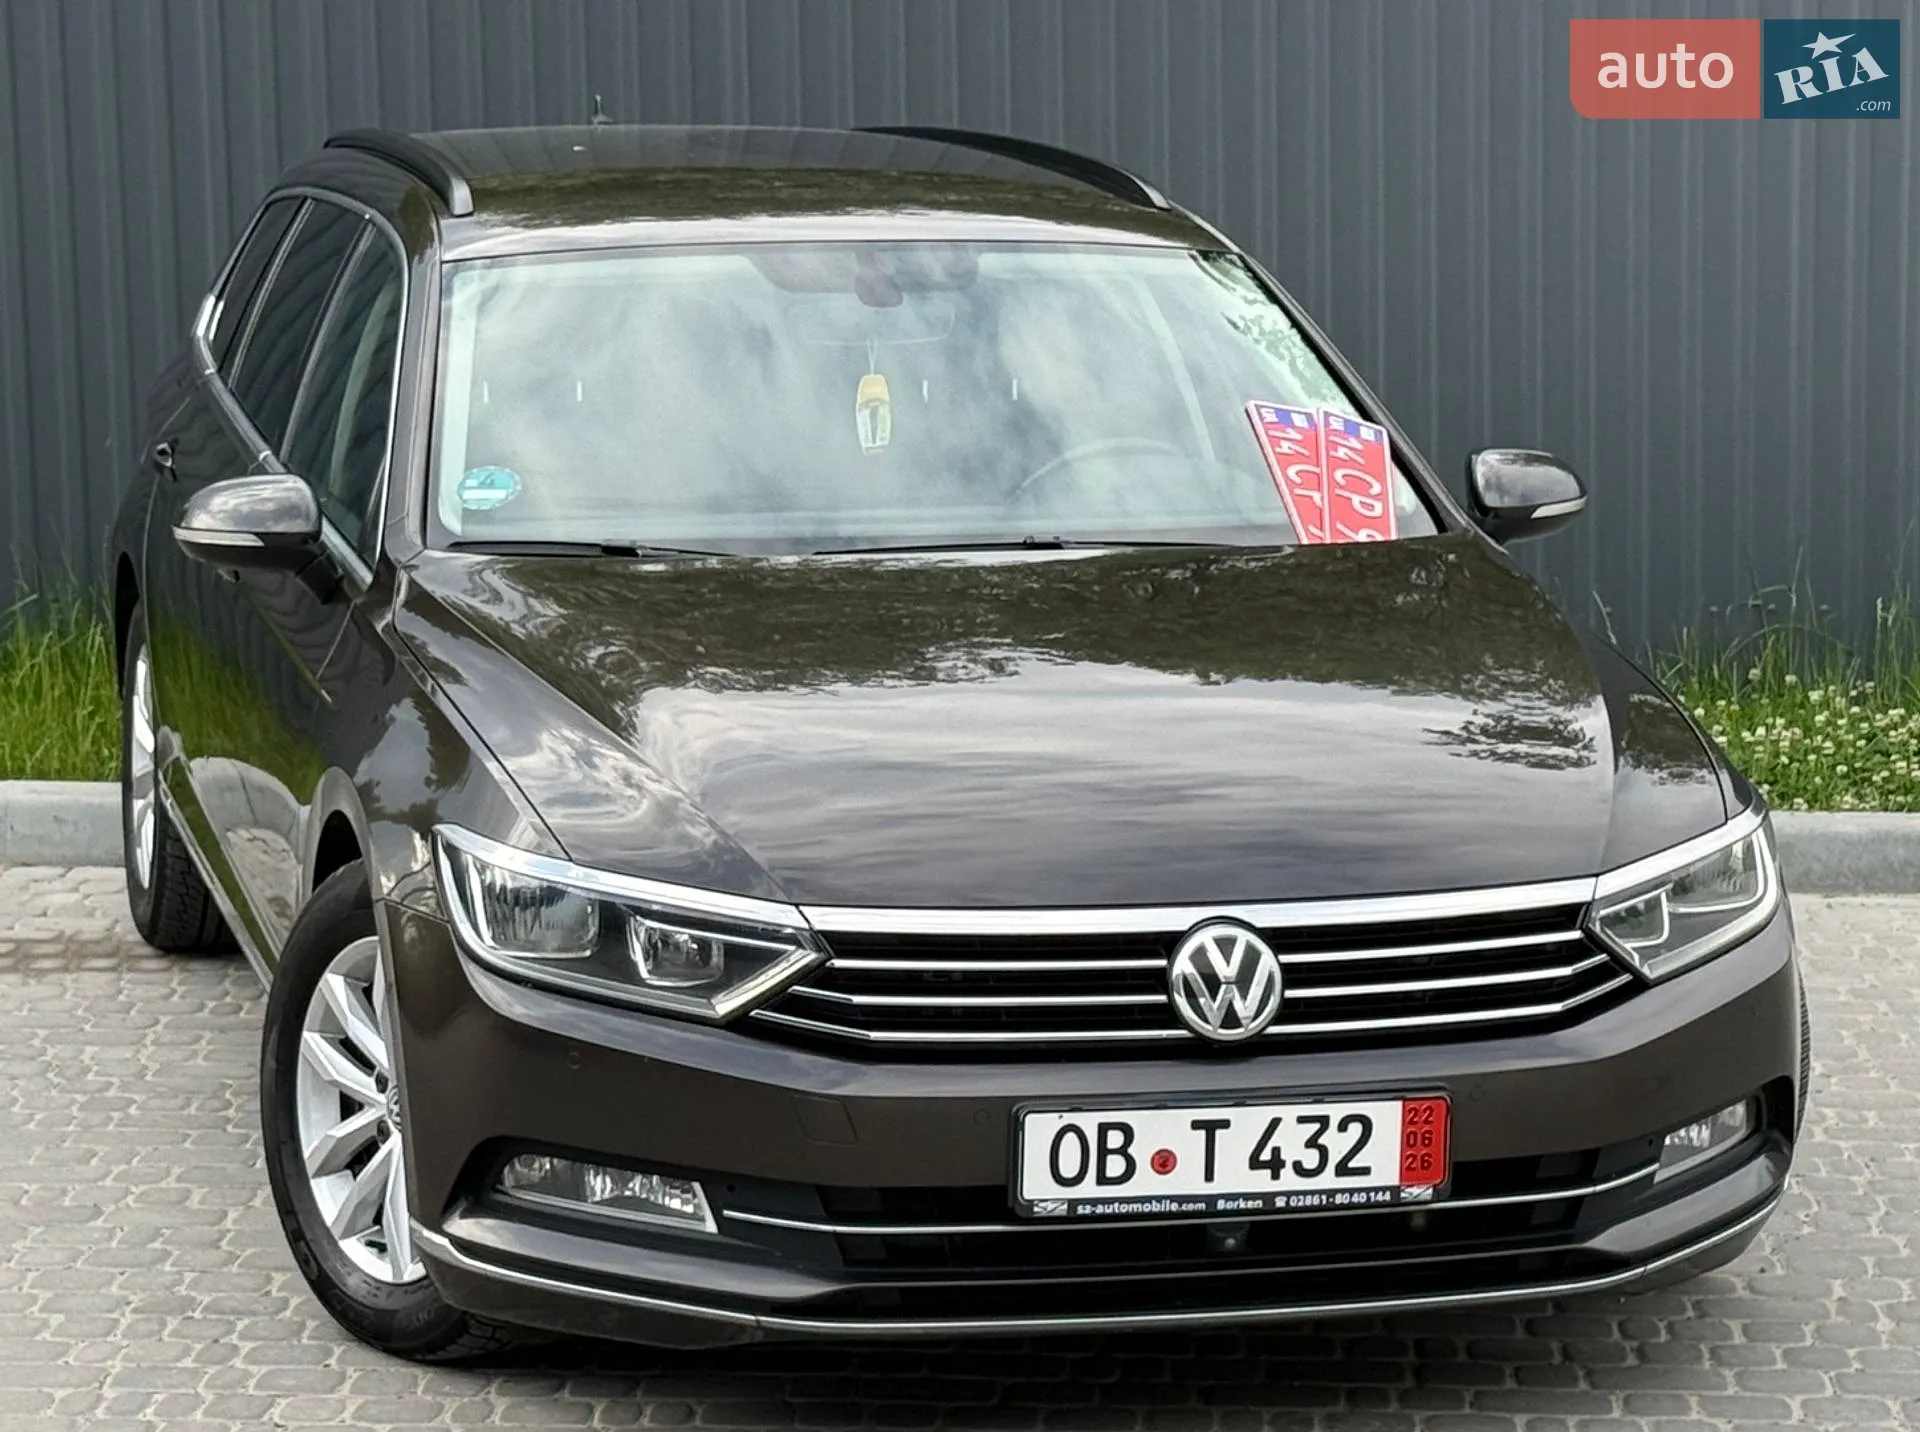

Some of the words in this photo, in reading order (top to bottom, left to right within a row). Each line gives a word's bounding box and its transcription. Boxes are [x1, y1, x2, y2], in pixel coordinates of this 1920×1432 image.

[1328, 434, 1365, 465] 14
[1407, 1104, 1435, 1125] 22
[1406, 1128, 1434, 1149] 06
[1049, 1121, 1138, 1189] OB
[1190, 1118, 1231, 1183] T
[1248, 1113, 1374, 1181] 432
[1405, 1151, 1433, 1171] 26
[1216, 1198, 1263, 1210] Borken
